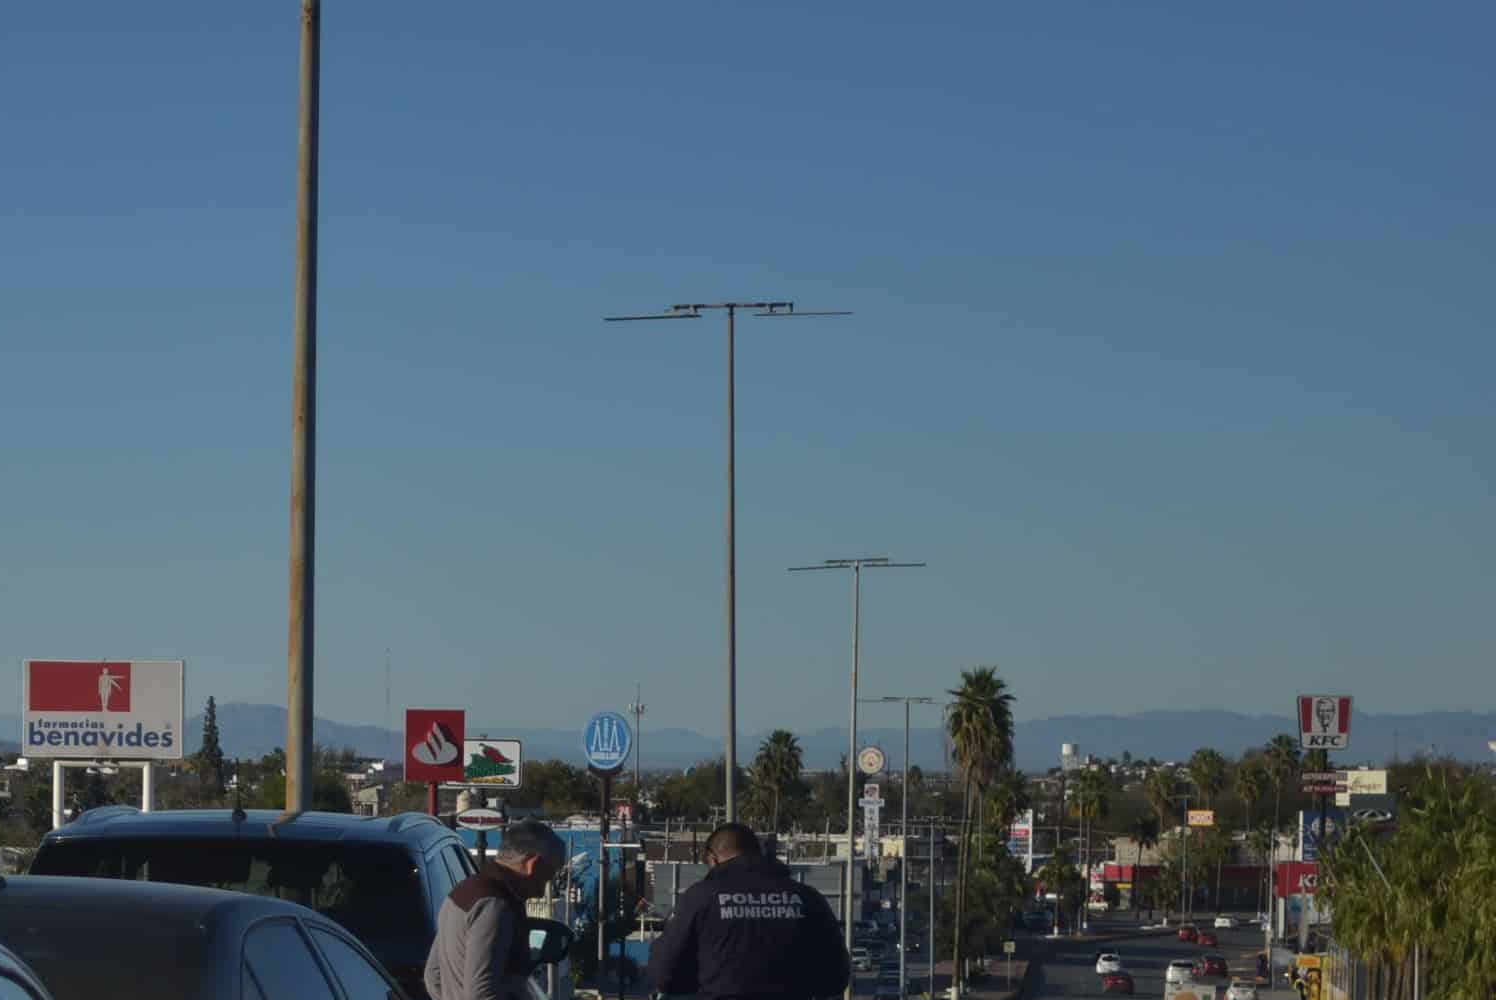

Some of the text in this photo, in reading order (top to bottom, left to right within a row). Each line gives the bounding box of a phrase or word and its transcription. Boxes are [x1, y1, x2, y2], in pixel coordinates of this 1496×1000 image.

[37, 718, 105, 729] farmacias
[29, 721, 173, 748] benavides
[1309, 735, 1341, 746] KFC
[720, 905, 806, 920] MUNICIPAL
